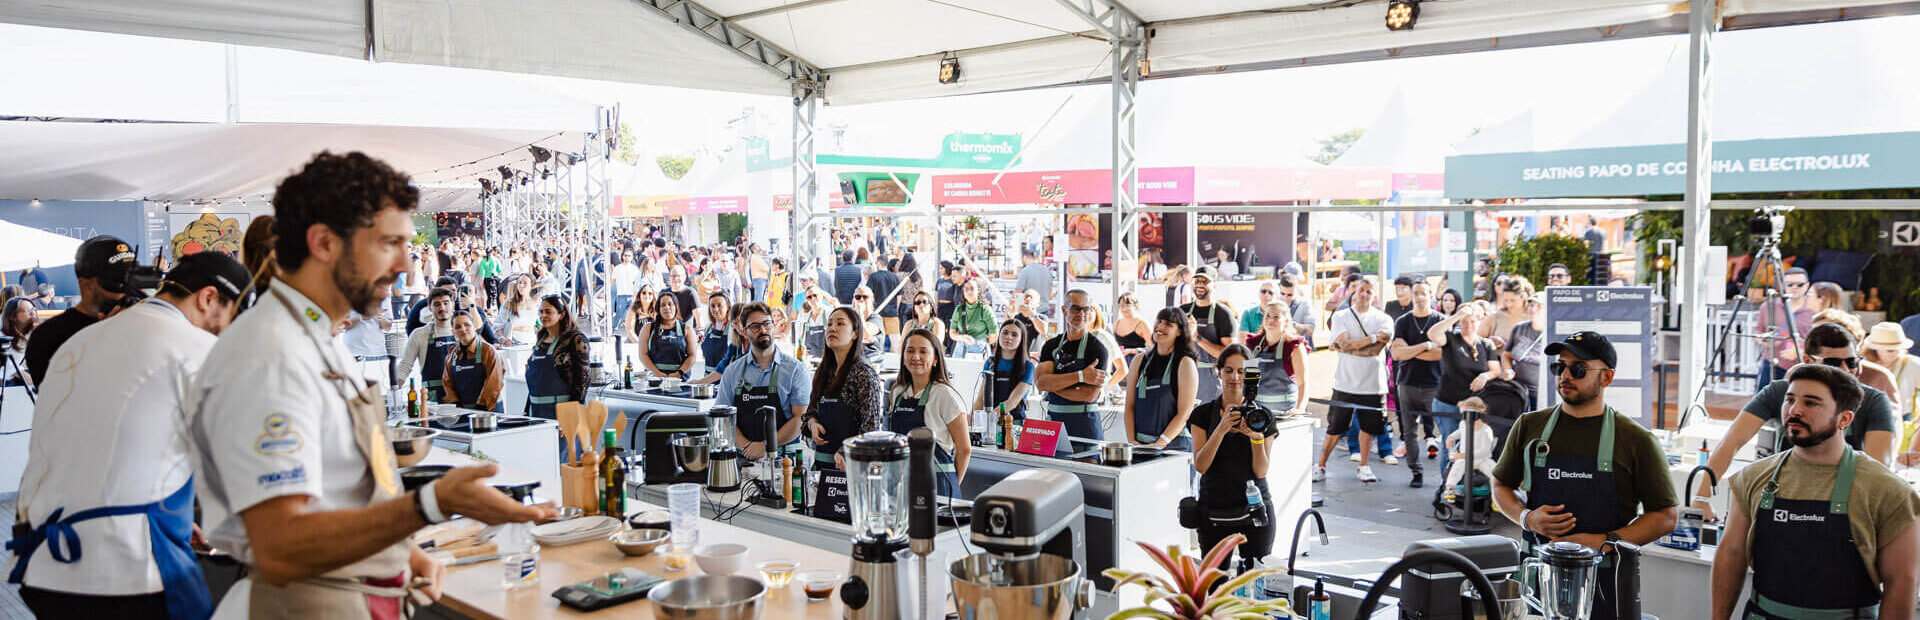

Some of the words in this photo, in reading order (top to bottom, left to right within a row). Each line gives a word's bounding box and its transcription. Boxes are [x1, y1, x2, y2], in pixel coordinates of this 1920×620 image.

[950, 141, 1014, 154] thermomix
[1522, 165, 1585, 180] SEATING
[1589, 163, 1633, 177] PAPO
[1636, 162, 1659, 176] DE
[1748, 154, 1871, 172] ELECTROLUX
[1026, 427, 1056, 436] RESERVADO
[1561, 471, 1593, 479] Electrolux
[1789, 513, 1825, 522] Electrolux
